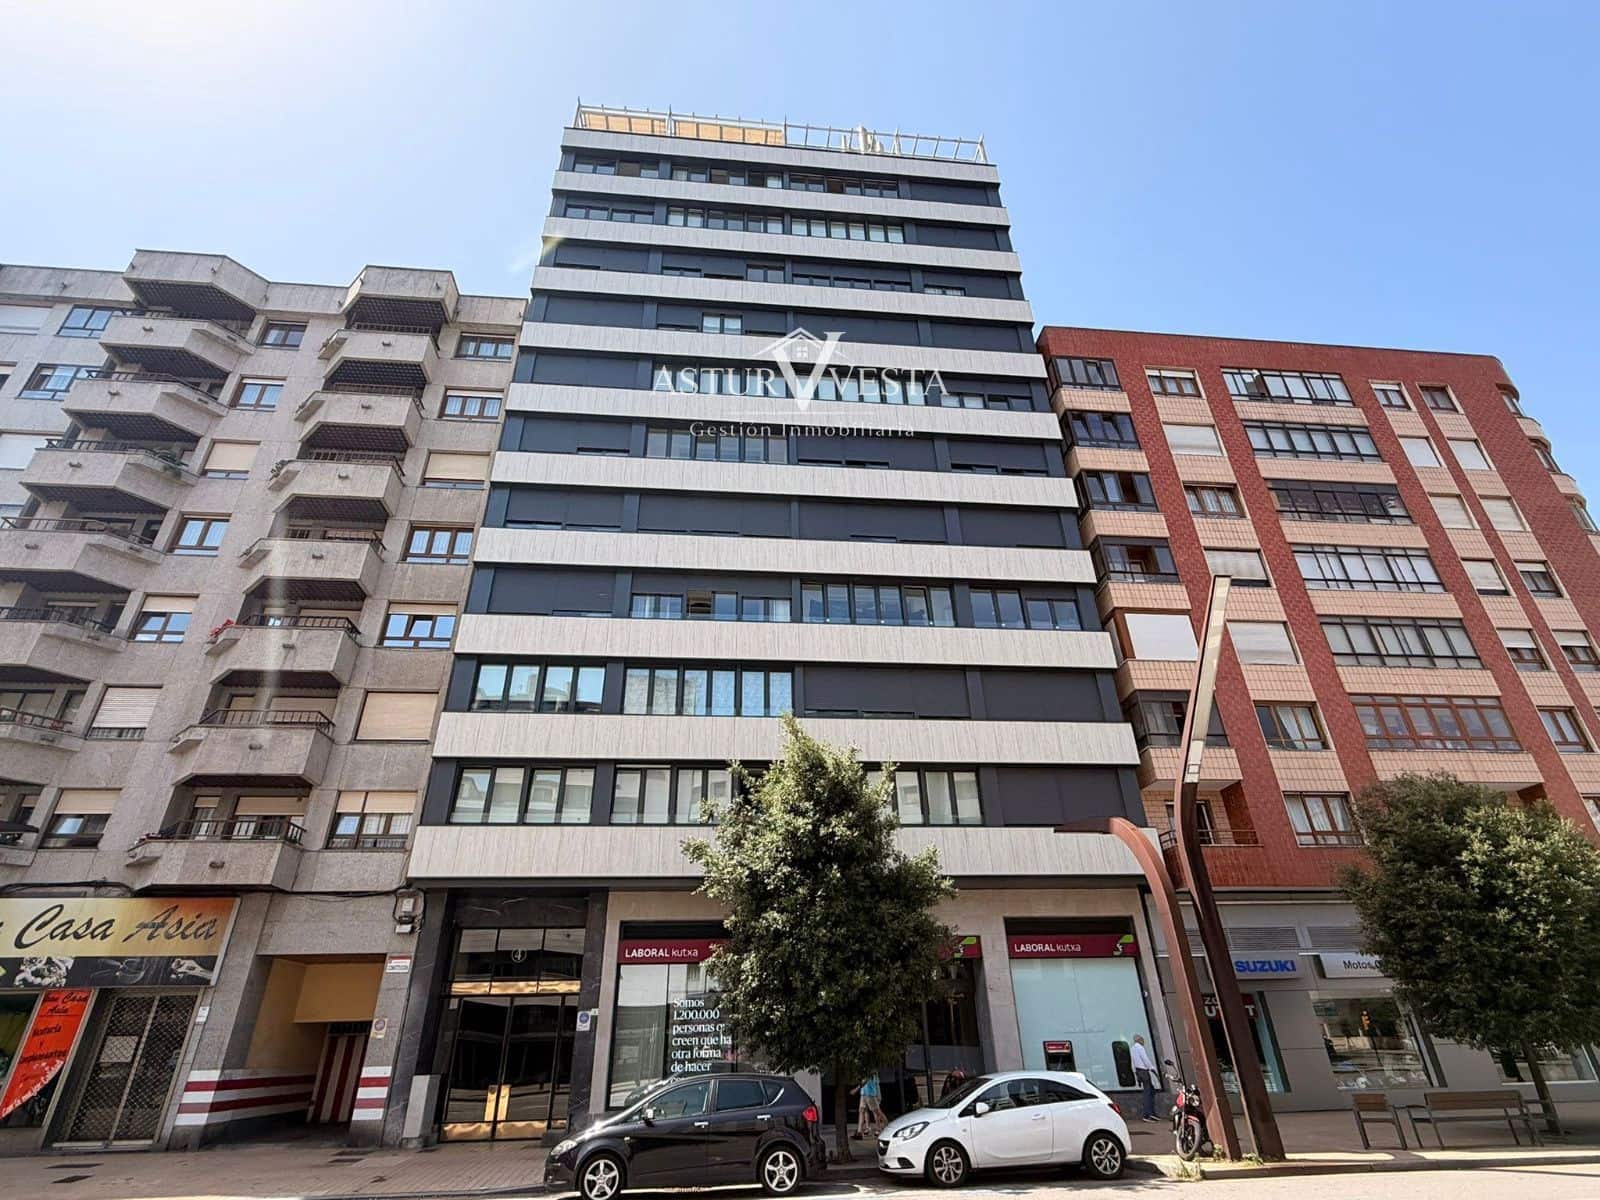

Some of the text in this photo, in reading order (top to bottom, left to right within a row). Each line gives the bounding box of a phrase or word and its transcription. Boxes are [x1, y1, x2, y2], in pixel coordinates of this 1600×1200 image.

[14, 903, 218, 950] Casa Asia
[625, 947, 698, 958] LABORAL kutxa
[1014, 943, 1081, 952] LABORAL kutxa
[1234, 960, 1296, 972] SUZUKI
[673, 999, 705, 1008] Somos
[672, 1024, 715, 1035] personas
[672, 1037, 699, 1046] creen
[700, 1036, 719, 1047] que
[671, 1047, 721, 1059] otra forma
[670, 1061, 712, 1072] de hacer
